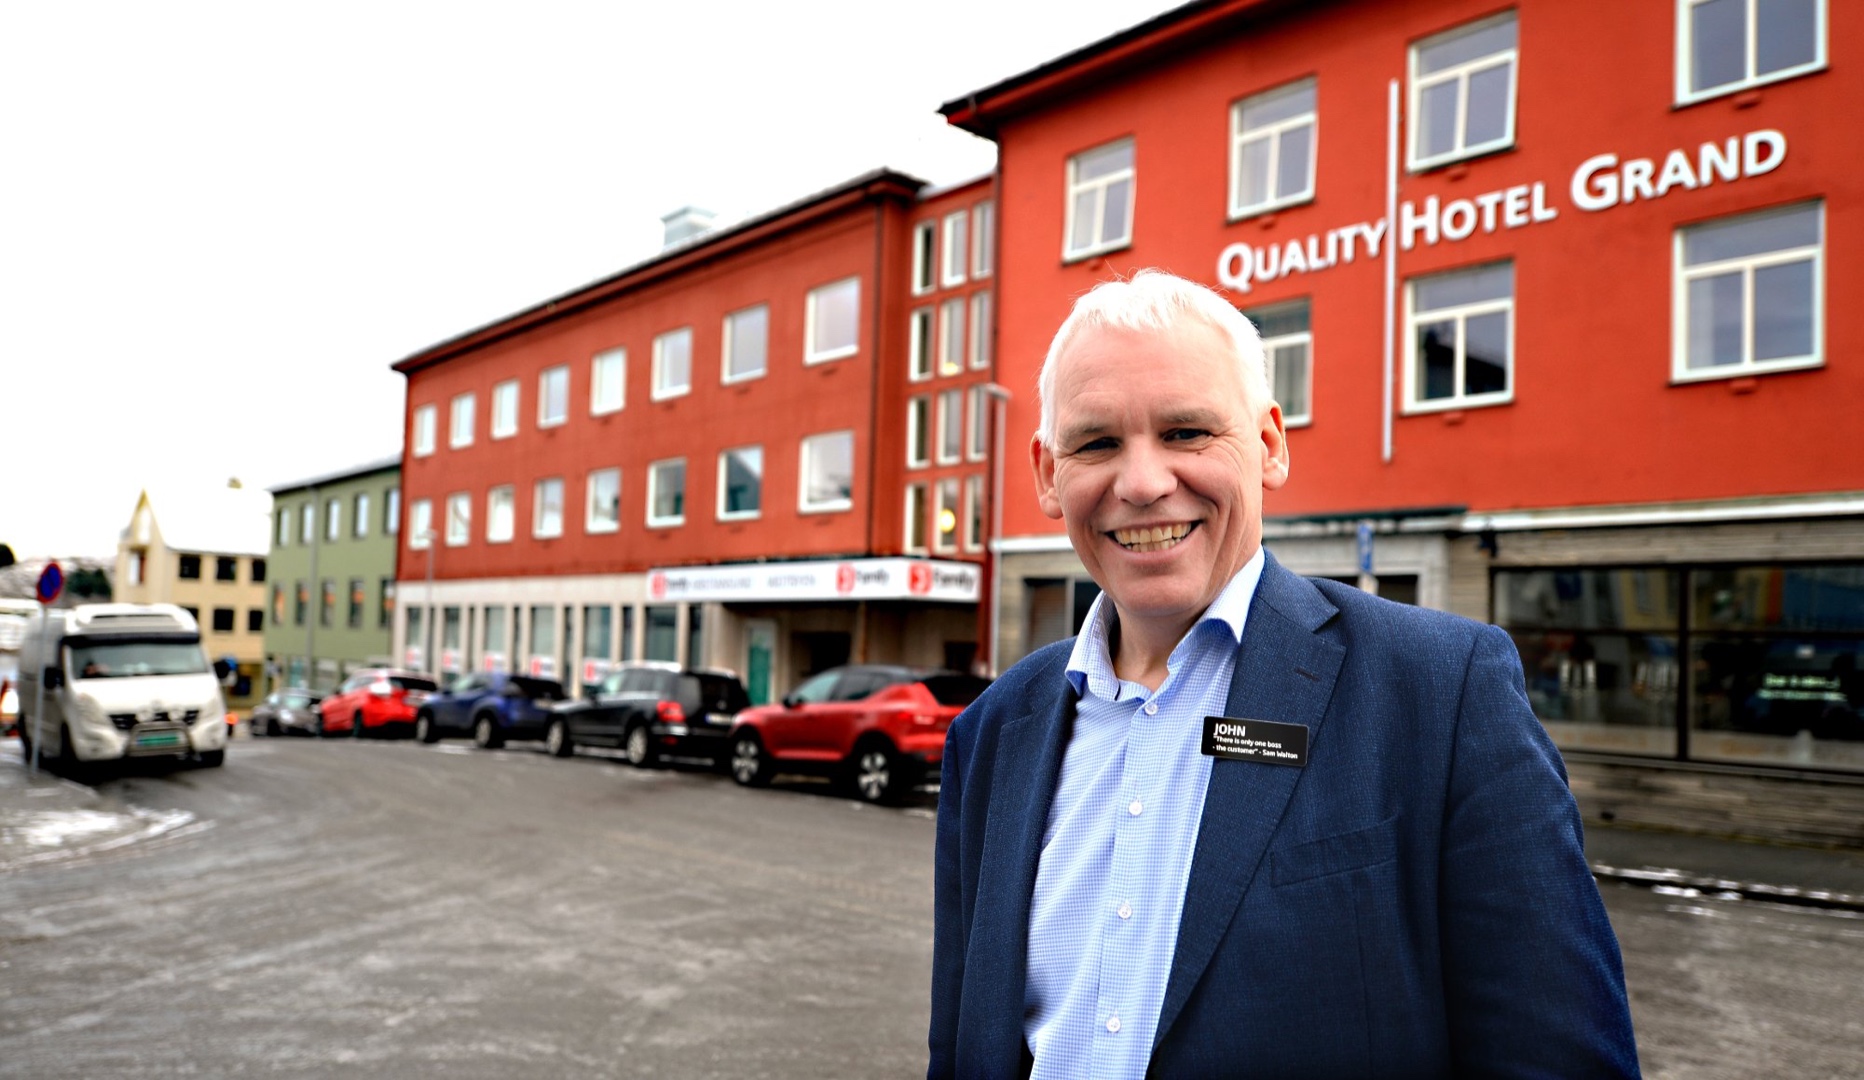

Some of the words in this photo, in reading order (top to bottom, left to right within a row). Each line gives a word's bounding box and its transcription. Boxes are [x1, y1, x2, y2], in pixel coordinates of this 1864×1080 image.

[1217, 218, 1387, 292] QUALITY
[1401, 182, 1557, 250] HOTEL
[1570, 130, 1786, 211] GRAND
[1213, 722, 1246, 737] JOHN
[1213, 735, 1234, 744] "There
[1240, 738, 1255, 747] only
[1267, 740, 1282, 749] boss
[1216, 744, 1227, 752] the
[1227, 746, 1259, 755] customer"
[1262, 749, 1276, 757] Sam
[1276, 751, 1298, 760] Walton
